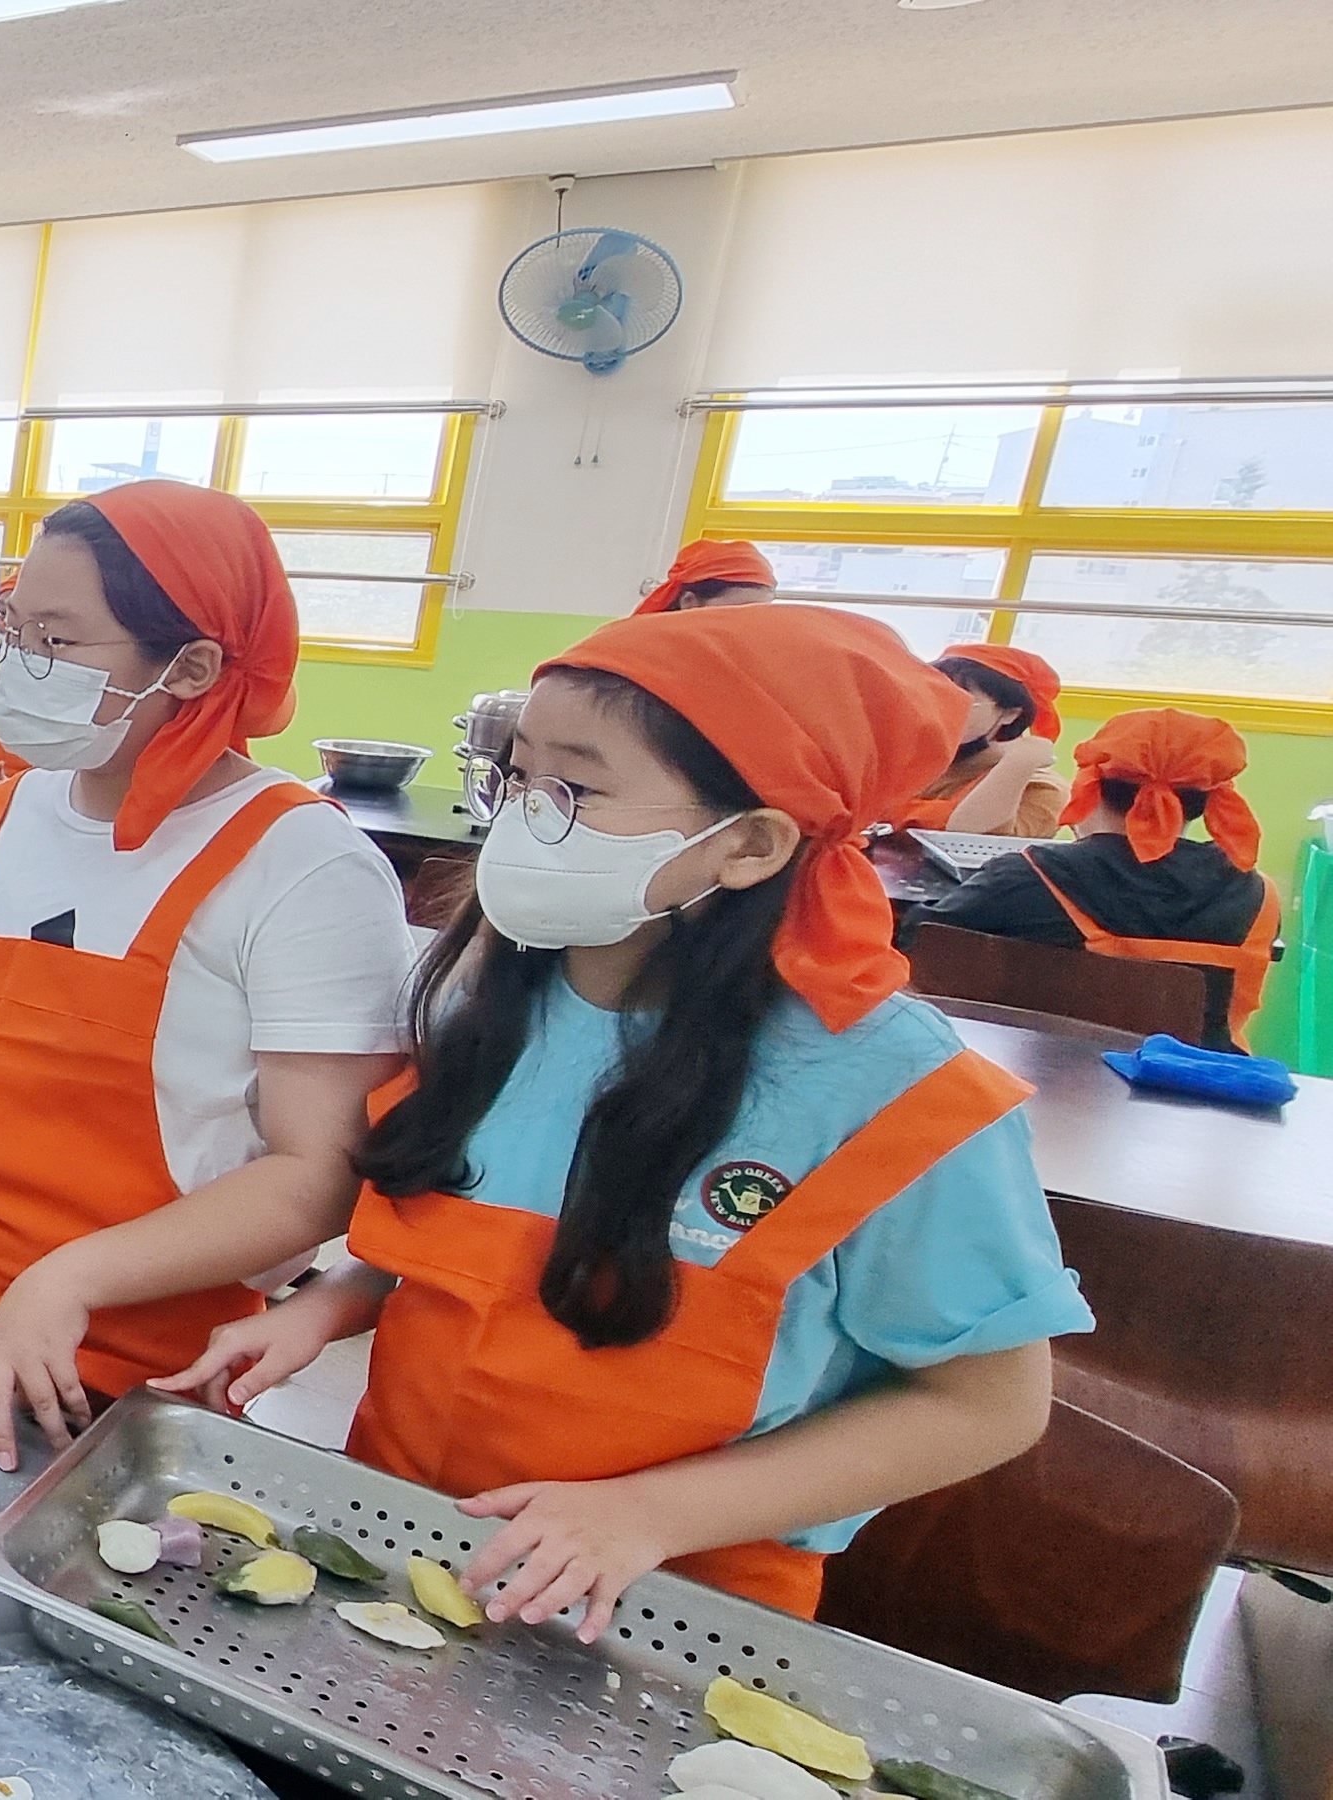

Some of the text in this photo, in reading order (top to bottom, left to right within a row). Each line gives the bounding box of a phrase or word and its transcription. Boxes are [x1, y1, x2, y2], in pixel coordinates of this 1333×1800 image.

[722, 1167, 788, 1194] GO GREEN
[726, 1214, 754, 1226] BAL
